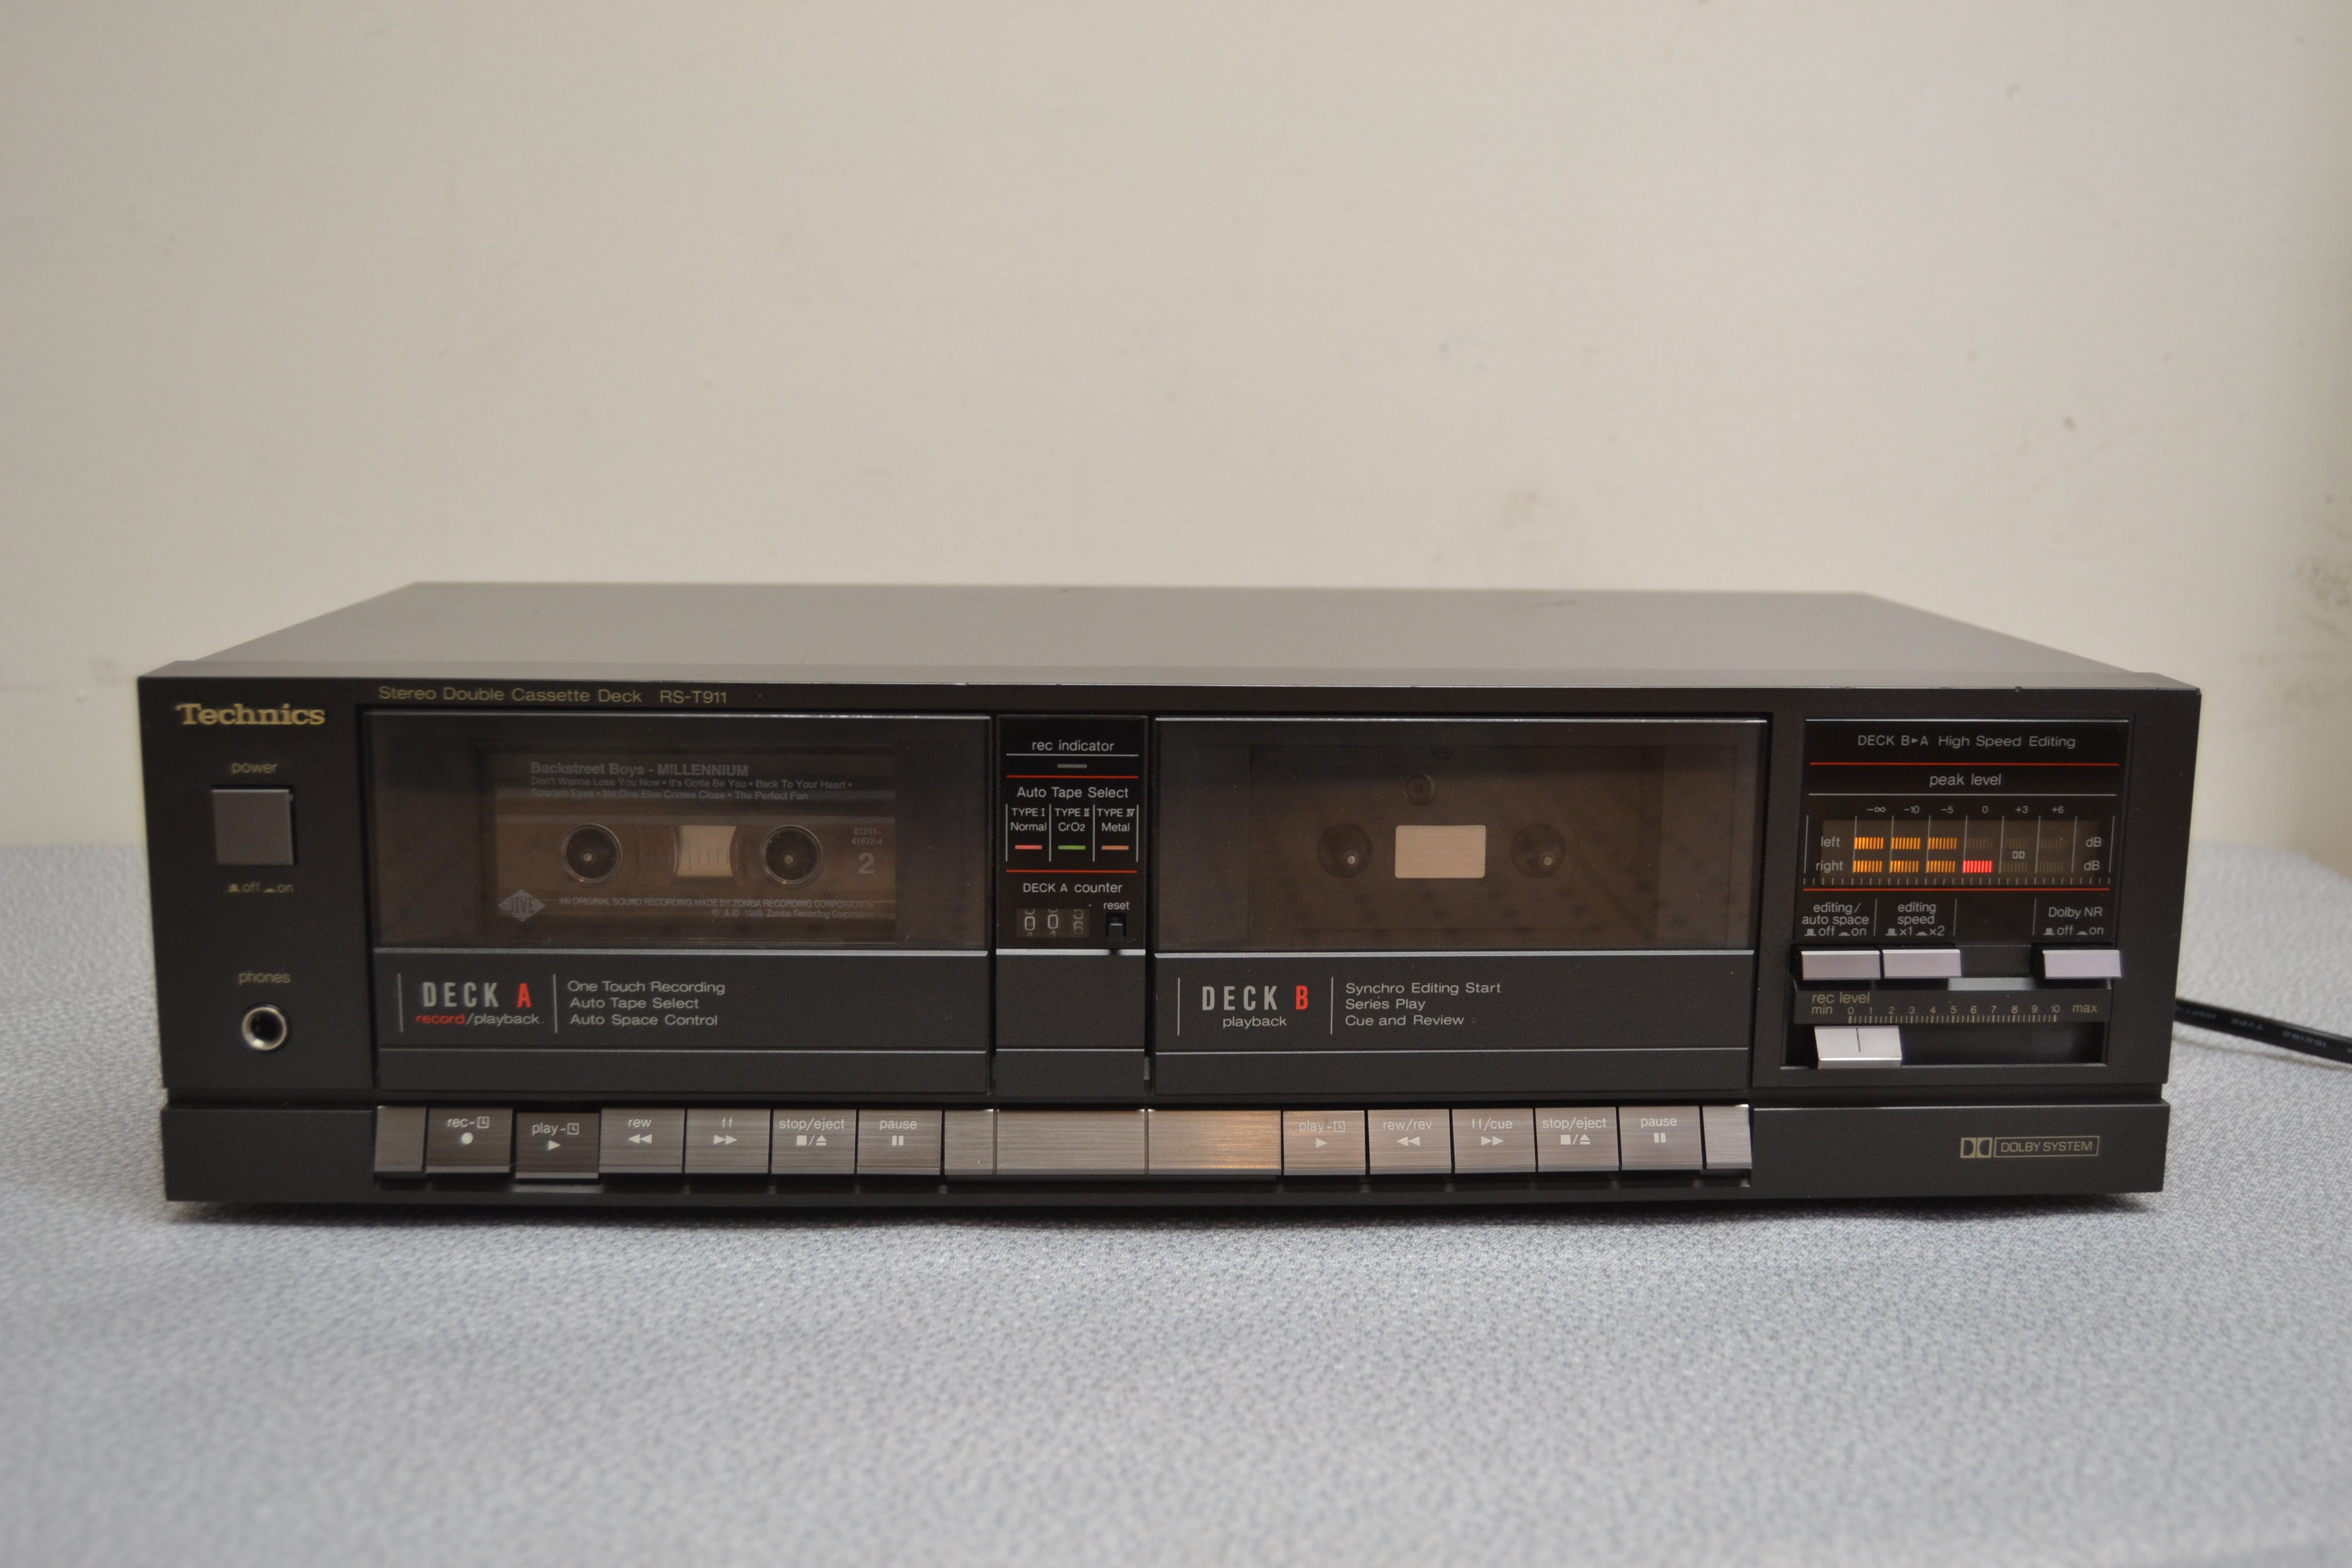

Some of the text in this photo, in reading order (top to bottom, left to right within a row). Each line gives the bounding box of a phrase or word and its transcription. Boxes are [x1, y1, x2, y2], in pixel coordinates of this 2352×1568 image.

[379, 685, 726, 704] Stereo Double Cassette Deck RS-T911
[176, 703, 326, 725] Technics
[1032, 740, 1114, 751] rec indicator
[1858, 735, 1895, 746] DECK
[1939, 736, 1970, 748] High
[1976, 736, 2021, 748] Speed
[2029, 736, 2076, 749] Editing
[232, 764, 278, 775] power
[531, 762, 749, 778] Backstreet Boys MILLENNIUM
[531, 776, 555, 785] Don't
[593, 778, 616, 786] Lose
[618, 778, 637, 787] You
[639, 778, 659, 787] Now
[685, 779, 709, 788] Gotta
[728, 780, 746, 788] You
[756, 780, 778, 788] Back
[796, 780, 818, 789] Your
[821, 780, 846, 789] Heart
[1929, 773, 2001, 788] peak level
[621, 790, 639, 798] One
[664, 791, 696, 799] Comes
[699, 791, 725, 799] Close
[734, 791, 752, 799] The
[755, 792, 787, 800] Perfect
[791, 792, 808, 800] Fan
[1017, 787, 1129, 799] Auto Tape Select
[1011, 807, 1038, 817] TYPE
[1055, 808, 1081, 817] TYPE
[1097, 808, 1123, 817] TYPE
[1011, 822, 1046, 831] Normal
[1101, 822, 1130, 832] Metal
[1821, 836, 1841, 847] left
[2086, 837, 2102, 847] dB
[858, 852, 875, 874] 2
[1816, 861, 1843, 873] right
[2084, 860, 2100, 871] dB
[242, 881, 295, 893] off on
[1023, 882, 1123, 893] DECK A counter
[1103, 901, 1130, 910] reset
[1813, 902, 1861, 914] editing/
[1898, 902, 1937, 914] editing
[2048, 906, 2103, 919] Dolby NR
[1802, 916, 1869, 926] auto space
[1897, 915, 1934, 926] speed
[1818, 925, 1867, 937] off on
[1899, 926, 1945, 936] x1 x2
[2056, 925, 2104, 936] off on
[239, 971, 291, 985] phones
[568, 981, 725, 995] One Touch Recording
[1345, 982, 1501, 995] Synchro Editing Start
[422, 982, 532, 1008] DECK A
[1202, 985, 1309, 1011] DECK B
[1812, 991, 1870, 1003] rec level
[570, 997, 699, 1010] Auto Tape Select
[1345, 998, 1426, 1011] Series Play
[1812, 1005, 1833, 1014] min
[1889, 1006, 1895, 1014] 2
[1950, 1006, 1956, 1014] 5
[1970, 1006, 1977, 1014] 6
[2031, 1005, 2038, 1013] 9
[2072, 1004, 2098, 1013] max
[570, 1014, 718, 1027] Auto Space Control
[1223, 1016, 1287, 1028] playback
[1345, 1015, 1464, 1025] Cue and Review
[627, 1118, 653, 1128] rew
[721, 1117, 733, 1128] ff
[779, 1117, 845, 1131] stop/eject
[879, 1119, 917, 1131] pause
[1383, 1118, 1432, 1131] rew/rev
[1471, 1118, 1513, 1131] ff/cue
[1543, 1117, 1607, 1130] stop/eject
[1640, 1118, 1677, 1128] pause
[2001, 1141, 2093, 1153] DOLBY SYSTEM
